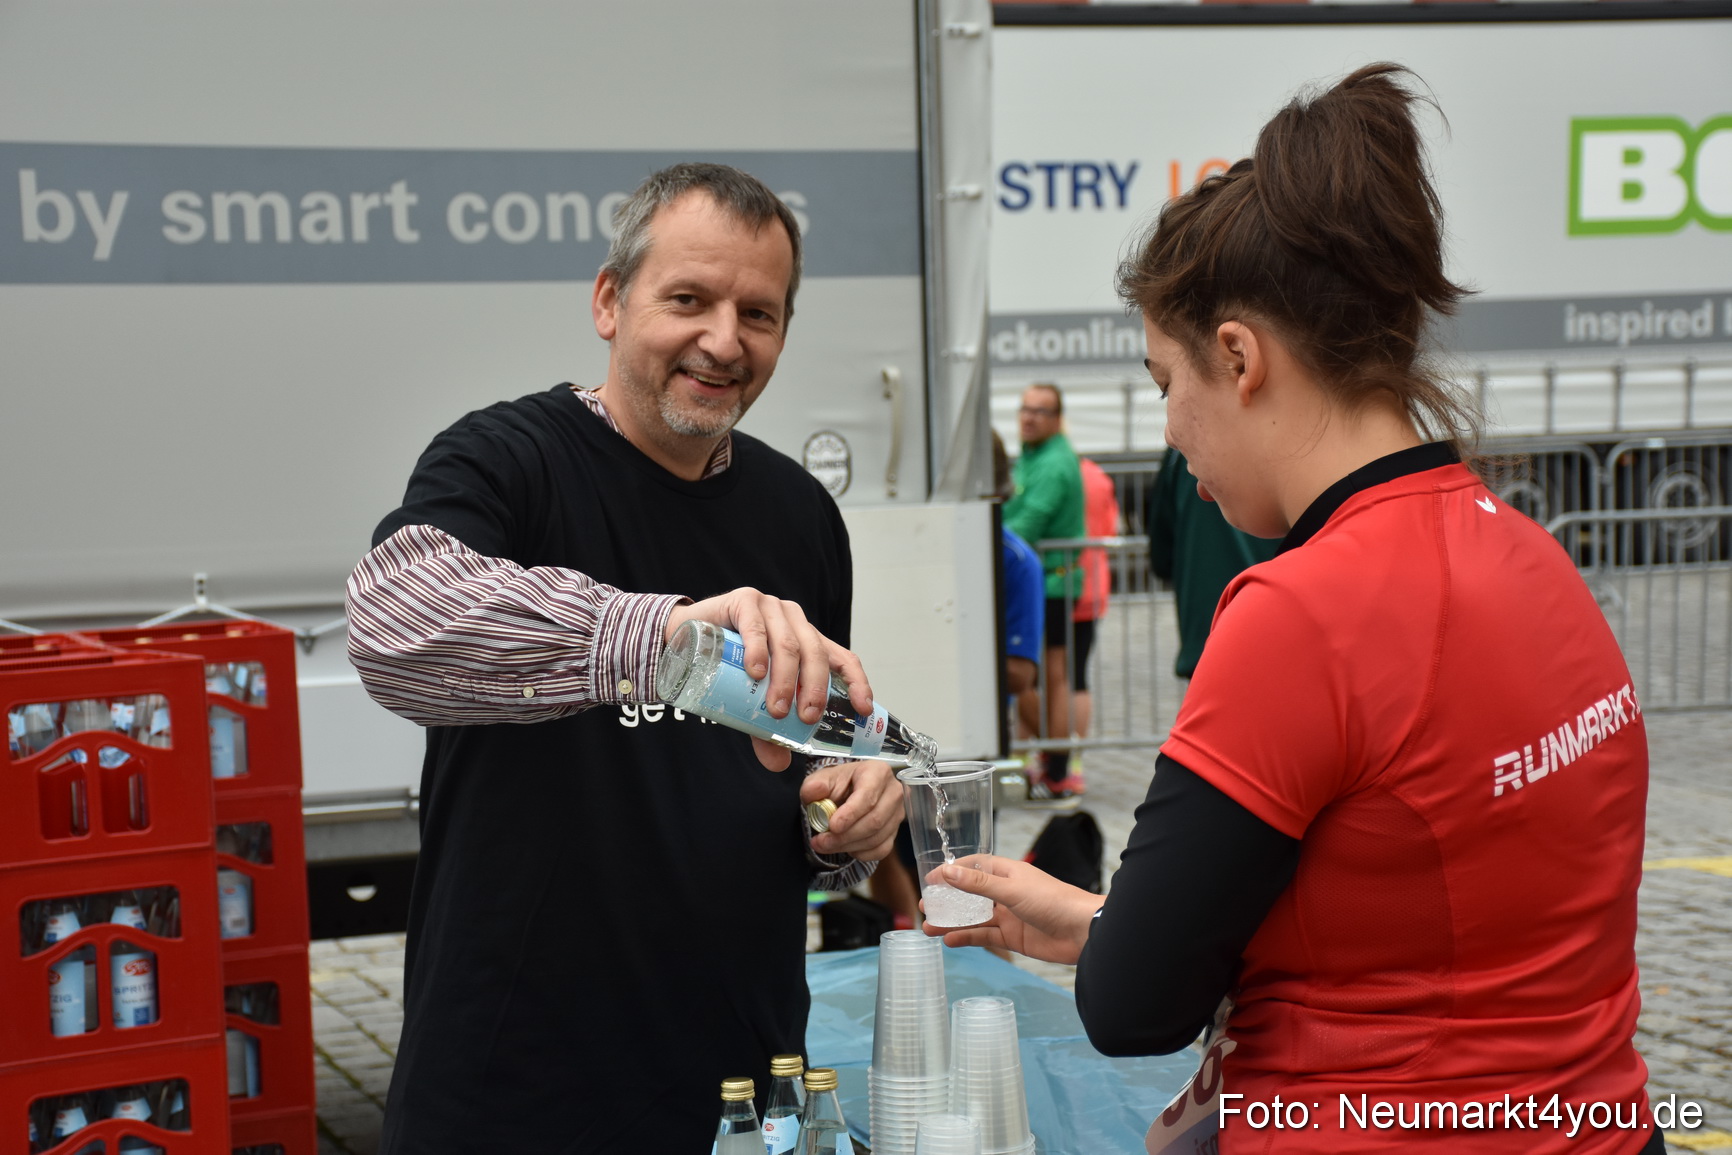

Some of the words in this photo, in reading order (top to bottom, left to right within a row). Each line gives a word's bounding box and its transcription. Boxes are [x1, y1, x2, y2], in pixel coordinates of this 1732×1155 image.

[996, 161, 1140, 215] STRY
[18, 168, 130, 261] by
[160, 180, 421, 244] smart
[988, 318, 1148, 361] ckonlin
[1564, 301, 1714, 347] inspired
